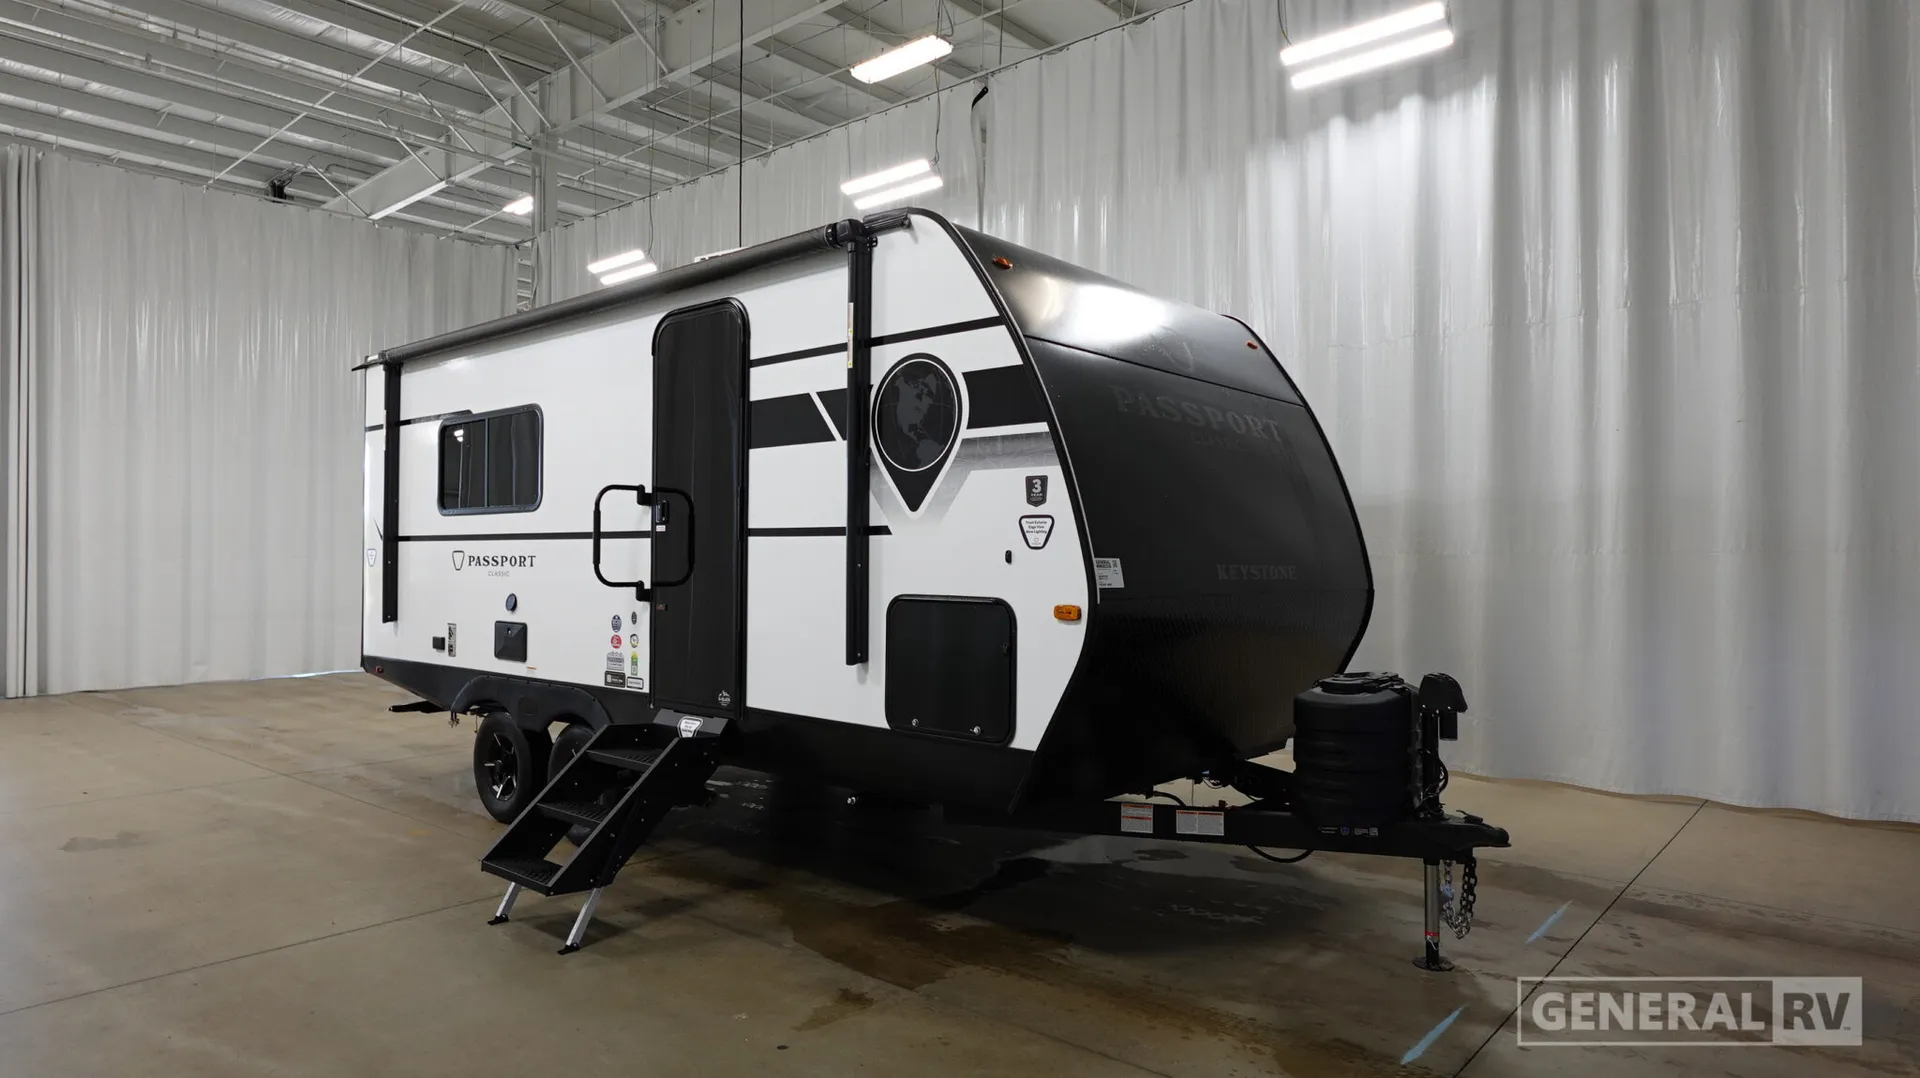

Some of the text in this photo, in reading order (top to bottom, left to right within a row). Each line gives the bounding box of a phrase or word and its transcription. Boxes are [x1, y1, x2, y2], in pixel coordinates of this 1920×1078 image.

[1107, 384, 1282, 442] PASSPORT
[1032, 479, 1042, 493] 3
[468, 555, 536, 567] PASSPORT
[1216, 563, 1298, 581] KEYSTONE
